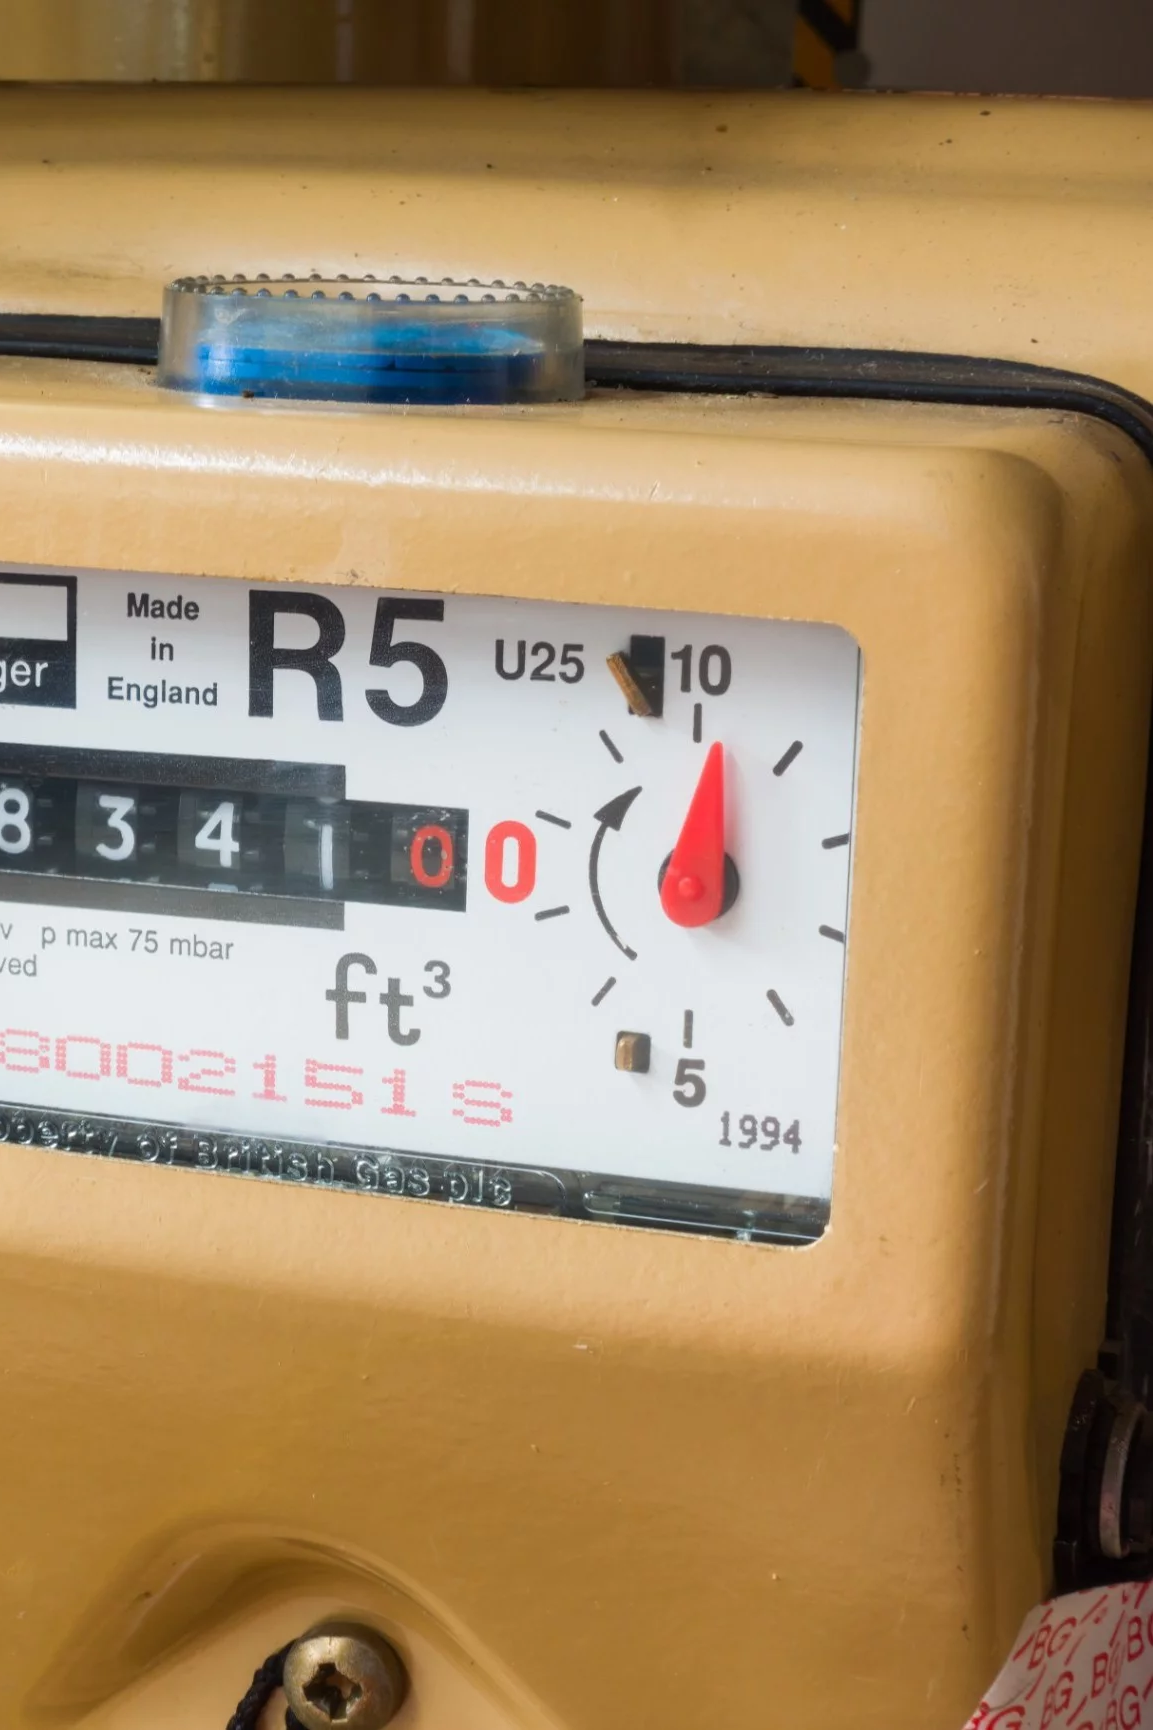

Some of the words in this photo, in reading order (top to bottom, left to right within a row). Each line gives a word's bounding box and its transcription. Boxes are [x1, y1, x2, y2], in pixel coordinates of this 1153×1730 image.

[127, 592, 201, 622] Made
[150, 636, 175, 661] in
[248, 588, 449, 727] R5
[494, 638, 586, 685] U25
[671, 643, 733, 696] 10
[107, 676, 219, 708] England
[41, 925, 56, 950] p
[67, 927, 118, 950] max
[128, 928, 159, 953] 75
[169, 933, 234, 960] mbar
[672, 1058, 707, 1107] 5
[719, 1110, 804, 1154] 1994
